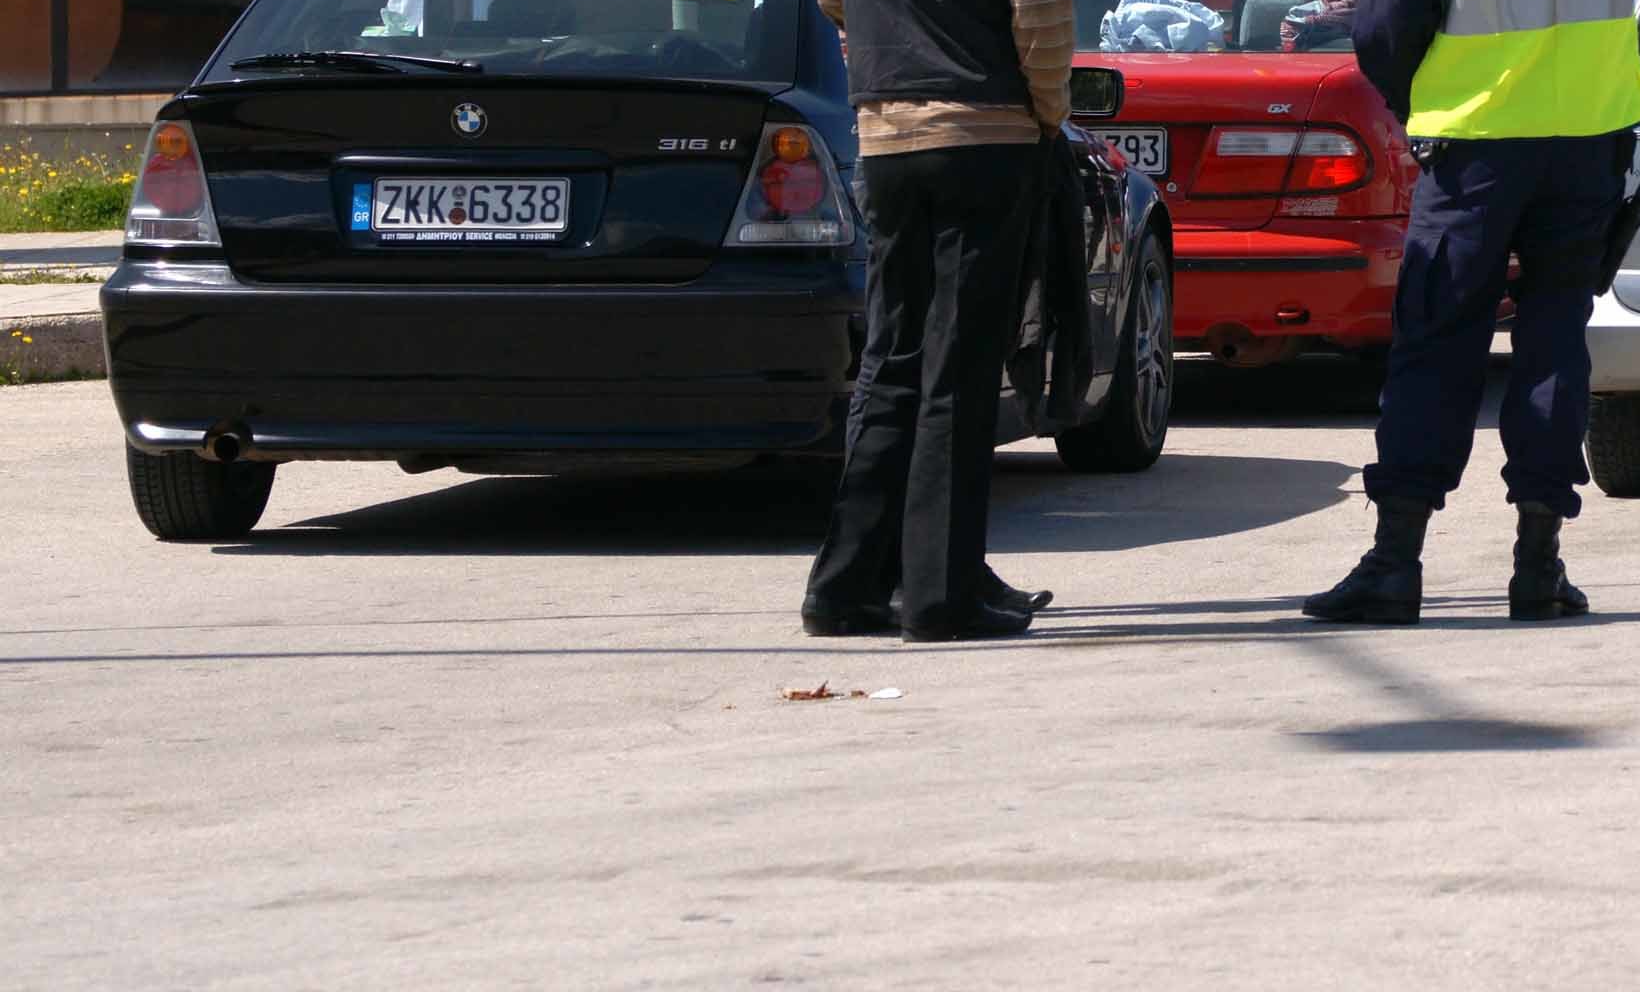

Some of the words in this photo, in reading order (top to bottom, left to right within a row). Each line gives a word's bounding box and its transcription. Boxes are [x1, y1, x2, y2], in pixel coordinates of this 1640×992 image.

[1267, 103, 1292, 113] GX
[657, 138, 709, 150] 316
[354, 211, 369, 223] GR
[465, 232, 493, 240] SERVICE
